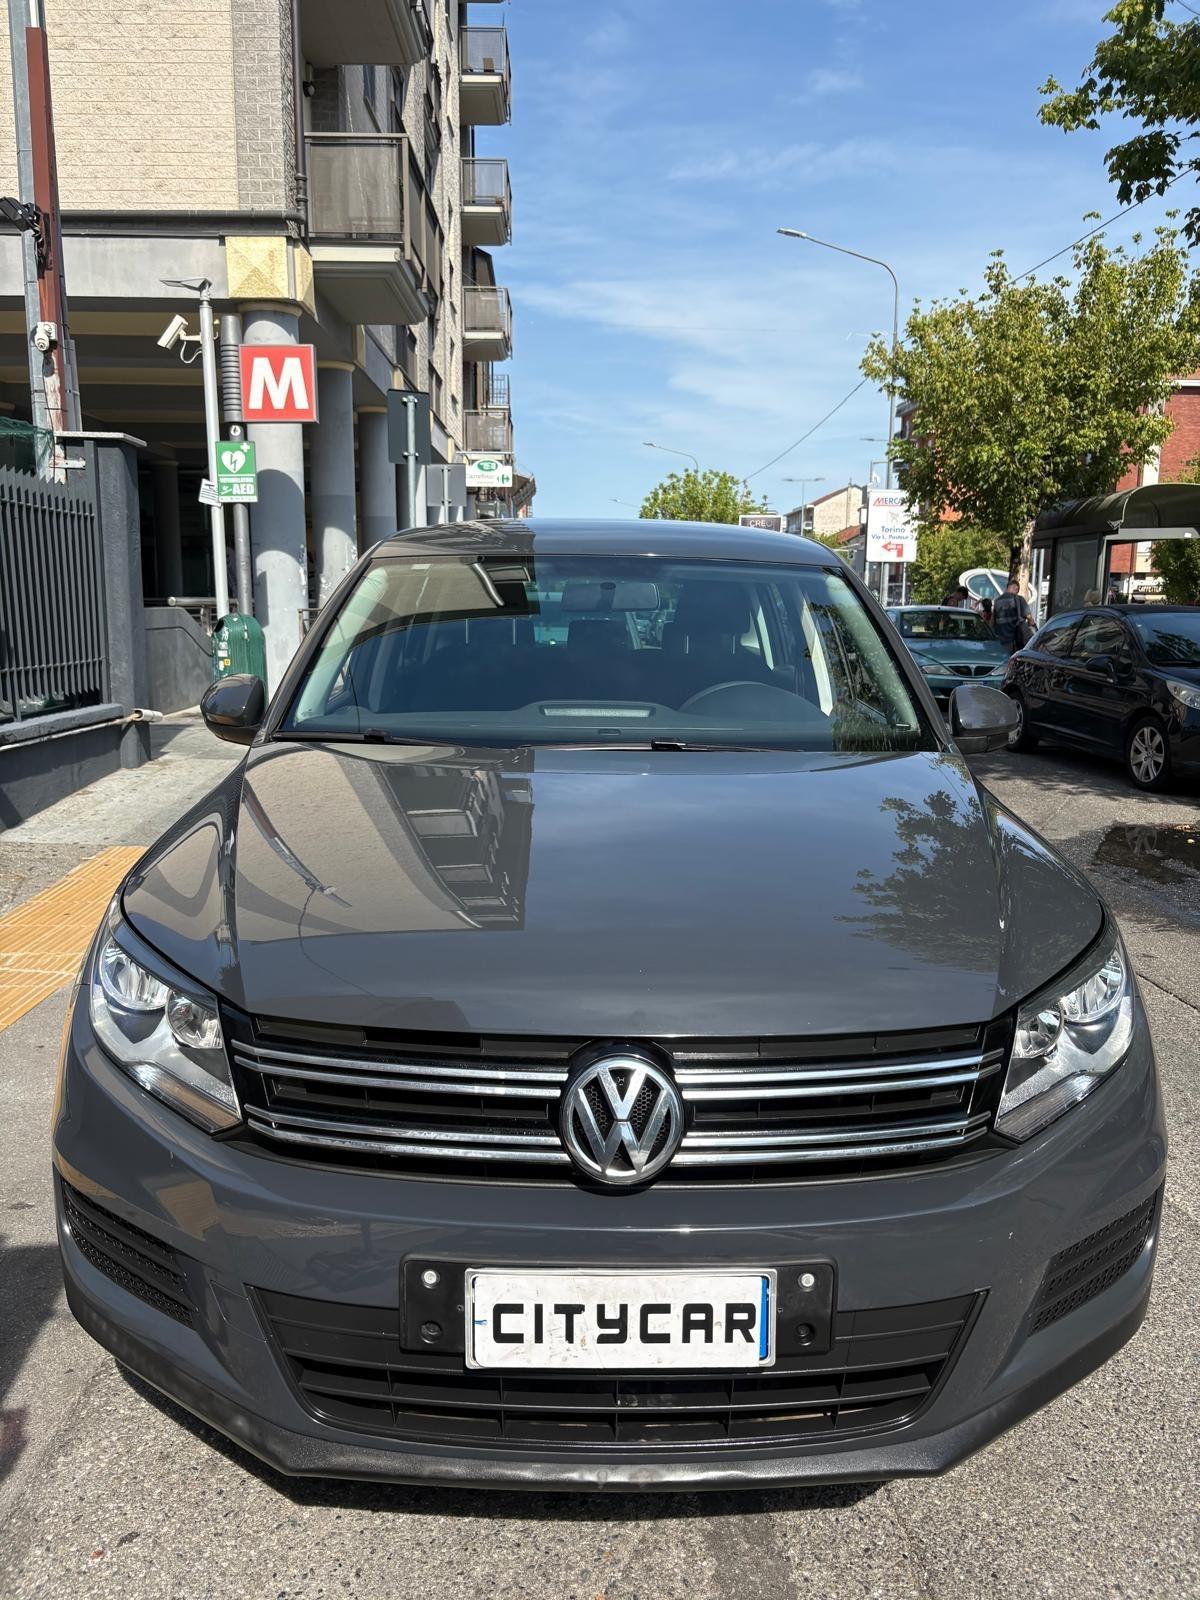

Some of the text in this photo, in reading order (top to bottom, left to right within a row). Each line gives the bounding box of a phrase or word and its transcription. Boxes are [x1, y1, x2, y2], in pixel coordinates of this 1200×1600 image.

[248, 357, 309, 410] M
[232, 484, 255, 495] AED
[881, 525, 906, 533] Torino
[492, 1302, 757, 1345] CITYCAR
